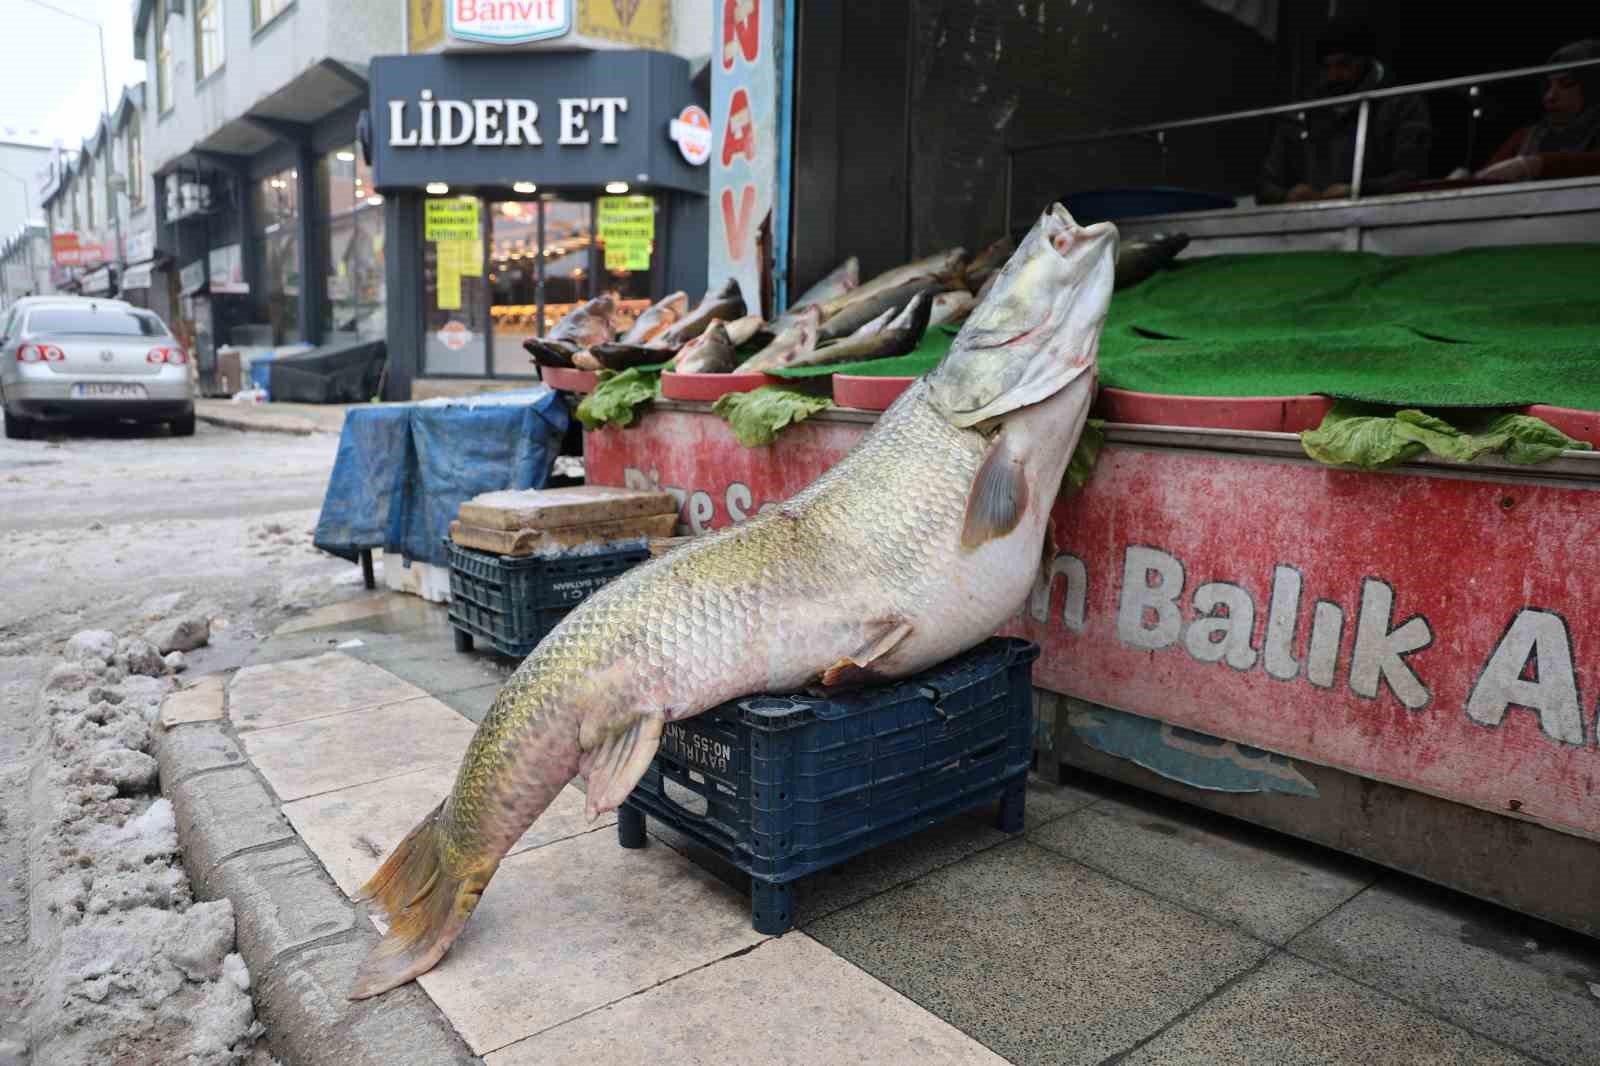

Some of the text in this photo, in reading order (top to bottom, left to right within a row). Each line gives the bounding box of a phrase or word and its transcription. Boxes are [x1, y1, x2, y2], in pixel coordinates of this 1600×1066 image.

[457, 0, 556, 22] Banvit
[388, 90, 542, 147] LİDER
[558, 97, 628, 145] ET
[1116, 545, 1434, 710] Balık
[693, 733, 730, 761] NO:55
